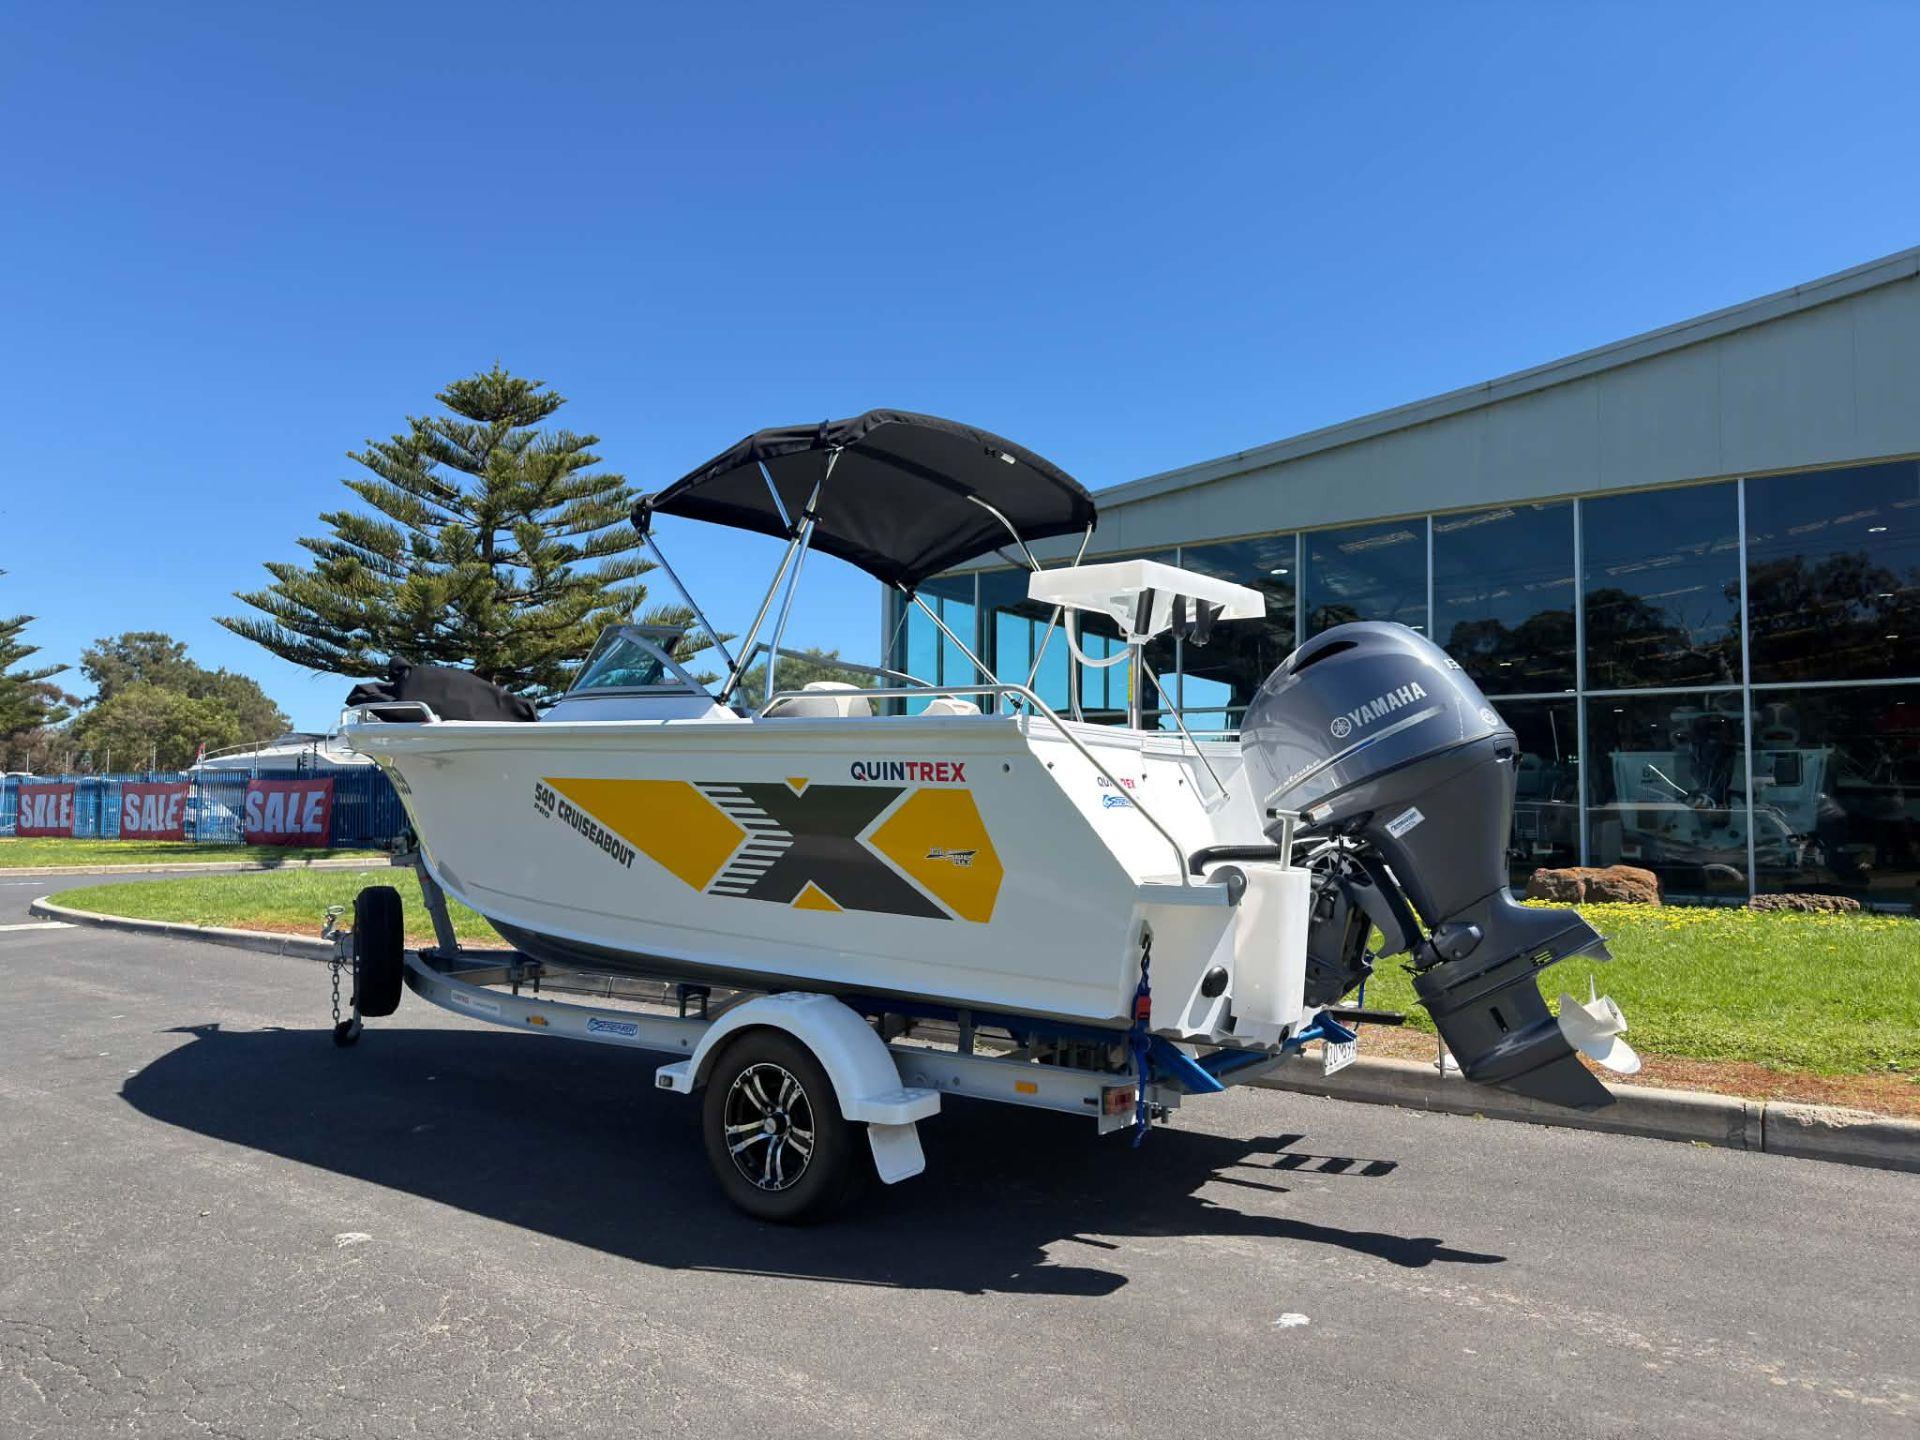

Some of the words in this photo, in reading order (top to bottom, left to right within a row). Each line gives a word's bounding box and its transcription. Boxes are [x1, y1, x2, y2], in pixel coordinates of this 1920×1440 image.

[1348, 681, 1427, 728] YAMAHA
[850, 761, 966, 782] QUINTREX
[20, 793, 72, 828] SALE
[124, 793, 183, 831] SALE
[245, 790, 326, 833] SALE
[533, 803, 550, 818] PRO
[534, 782, 555, 812] 540
[558, 799, 636, 869] CRUISEABOUT
